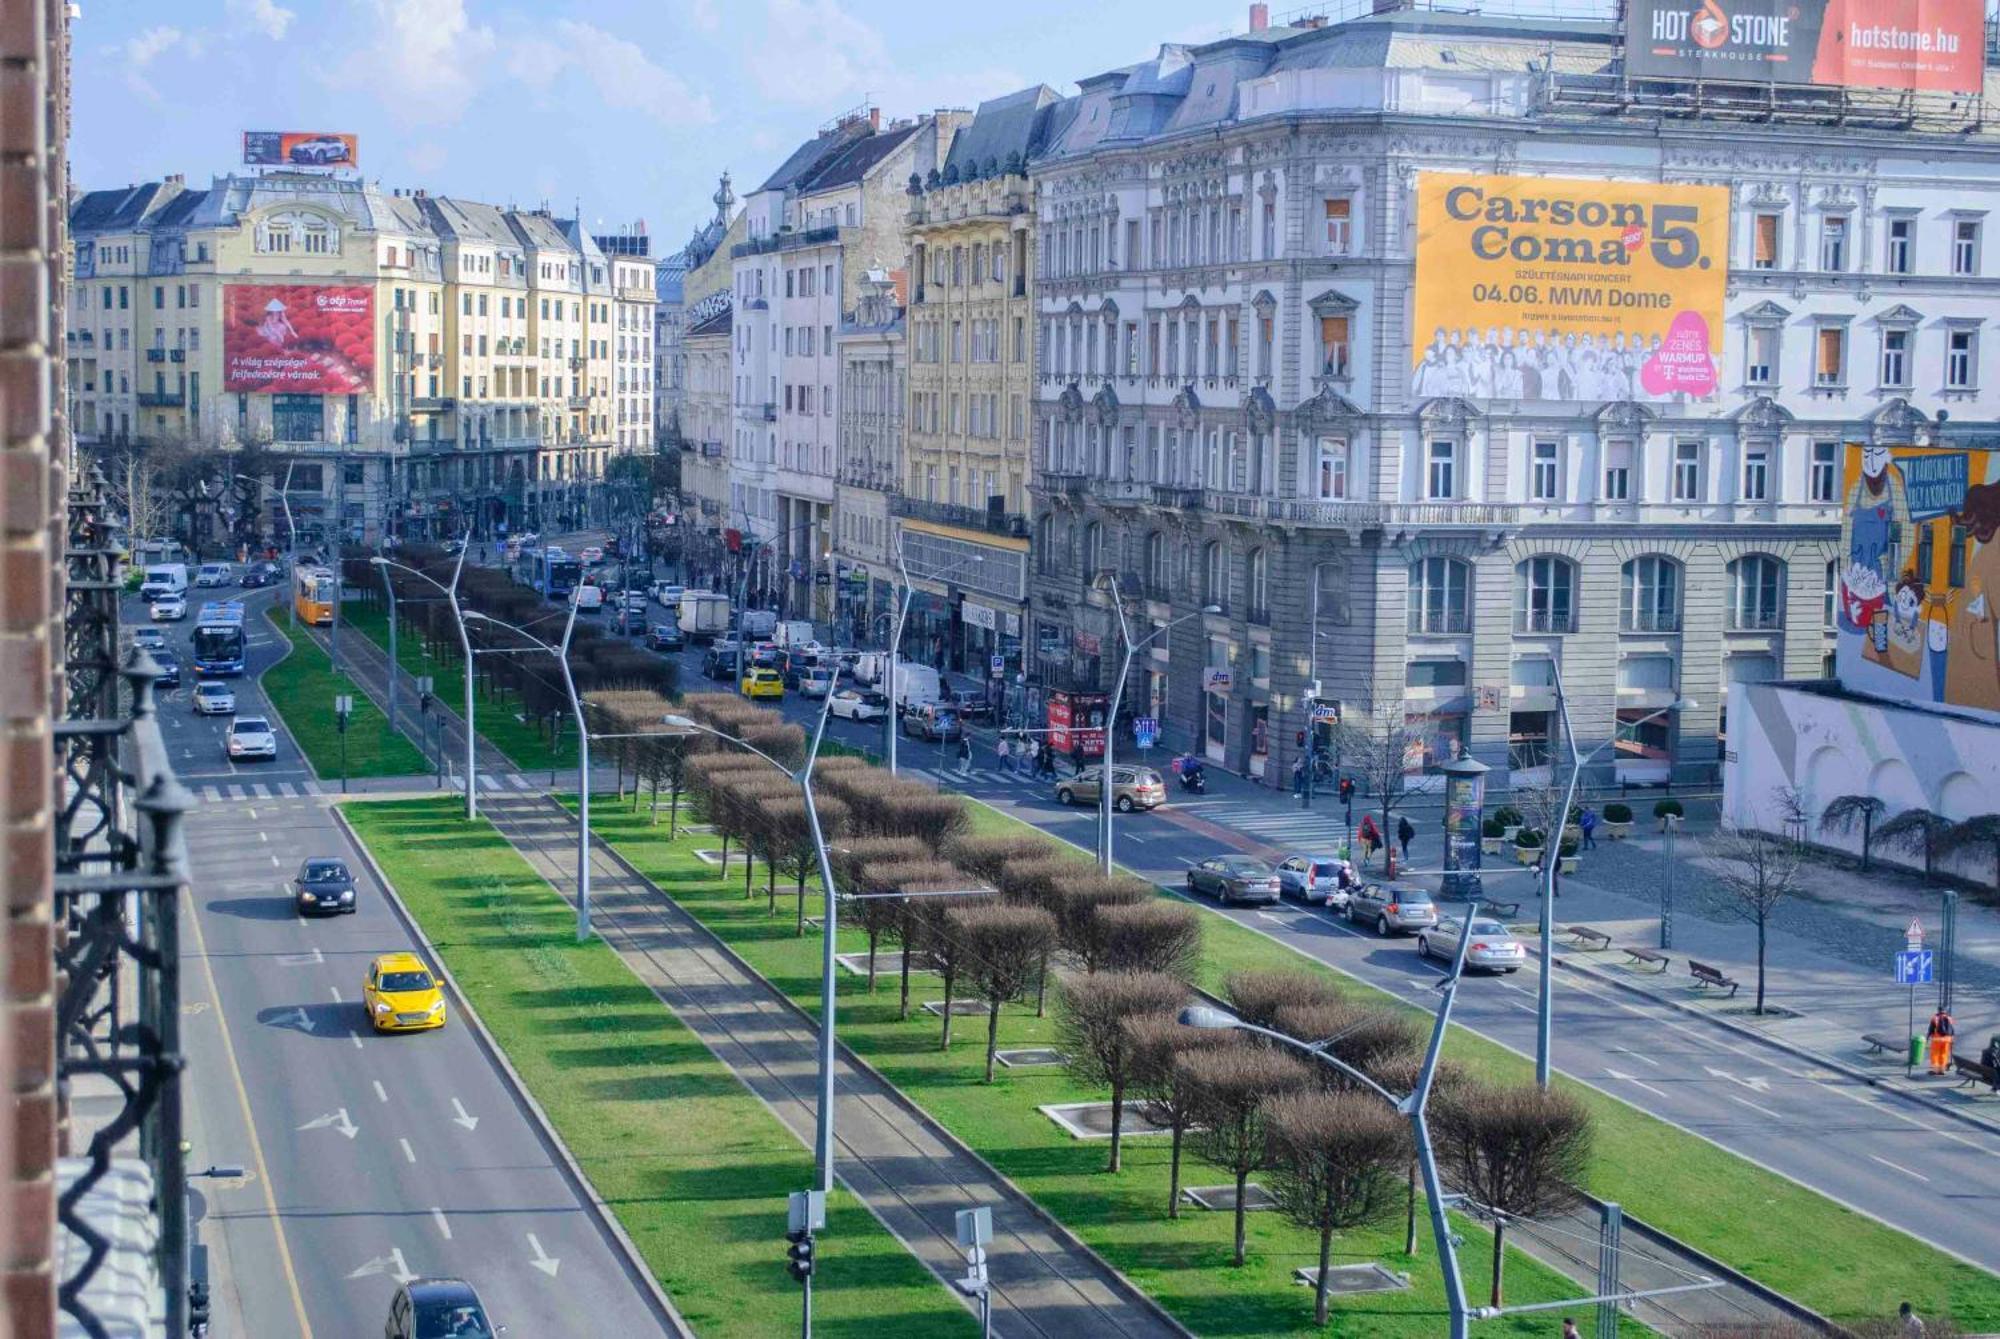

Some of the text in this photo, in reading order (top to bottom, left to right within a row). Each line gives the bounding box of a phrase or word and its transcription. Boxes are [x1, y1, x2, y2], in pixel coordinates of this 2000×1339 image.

[1652, 10, 1789, 47] HOT STONE
[1850, 21, 1958, 53] hotstone.hu
[1678, 48, 1763, 62] STEAKHOUSE
[1445, 186, 1648, 228] Carson
[1471, 225, 1631, 265] Coma
[1651, 204, 1711, 270] 5.
[1587, 273, 1631, 283] KONCERT
[1473, 283, 1672, 309] 04.06. MVM Dome
[1659, 352, 1704, 363] WARMUP
[1212, 671, 1229, 681] dm
[1314, 703, 1336, 717] dm
